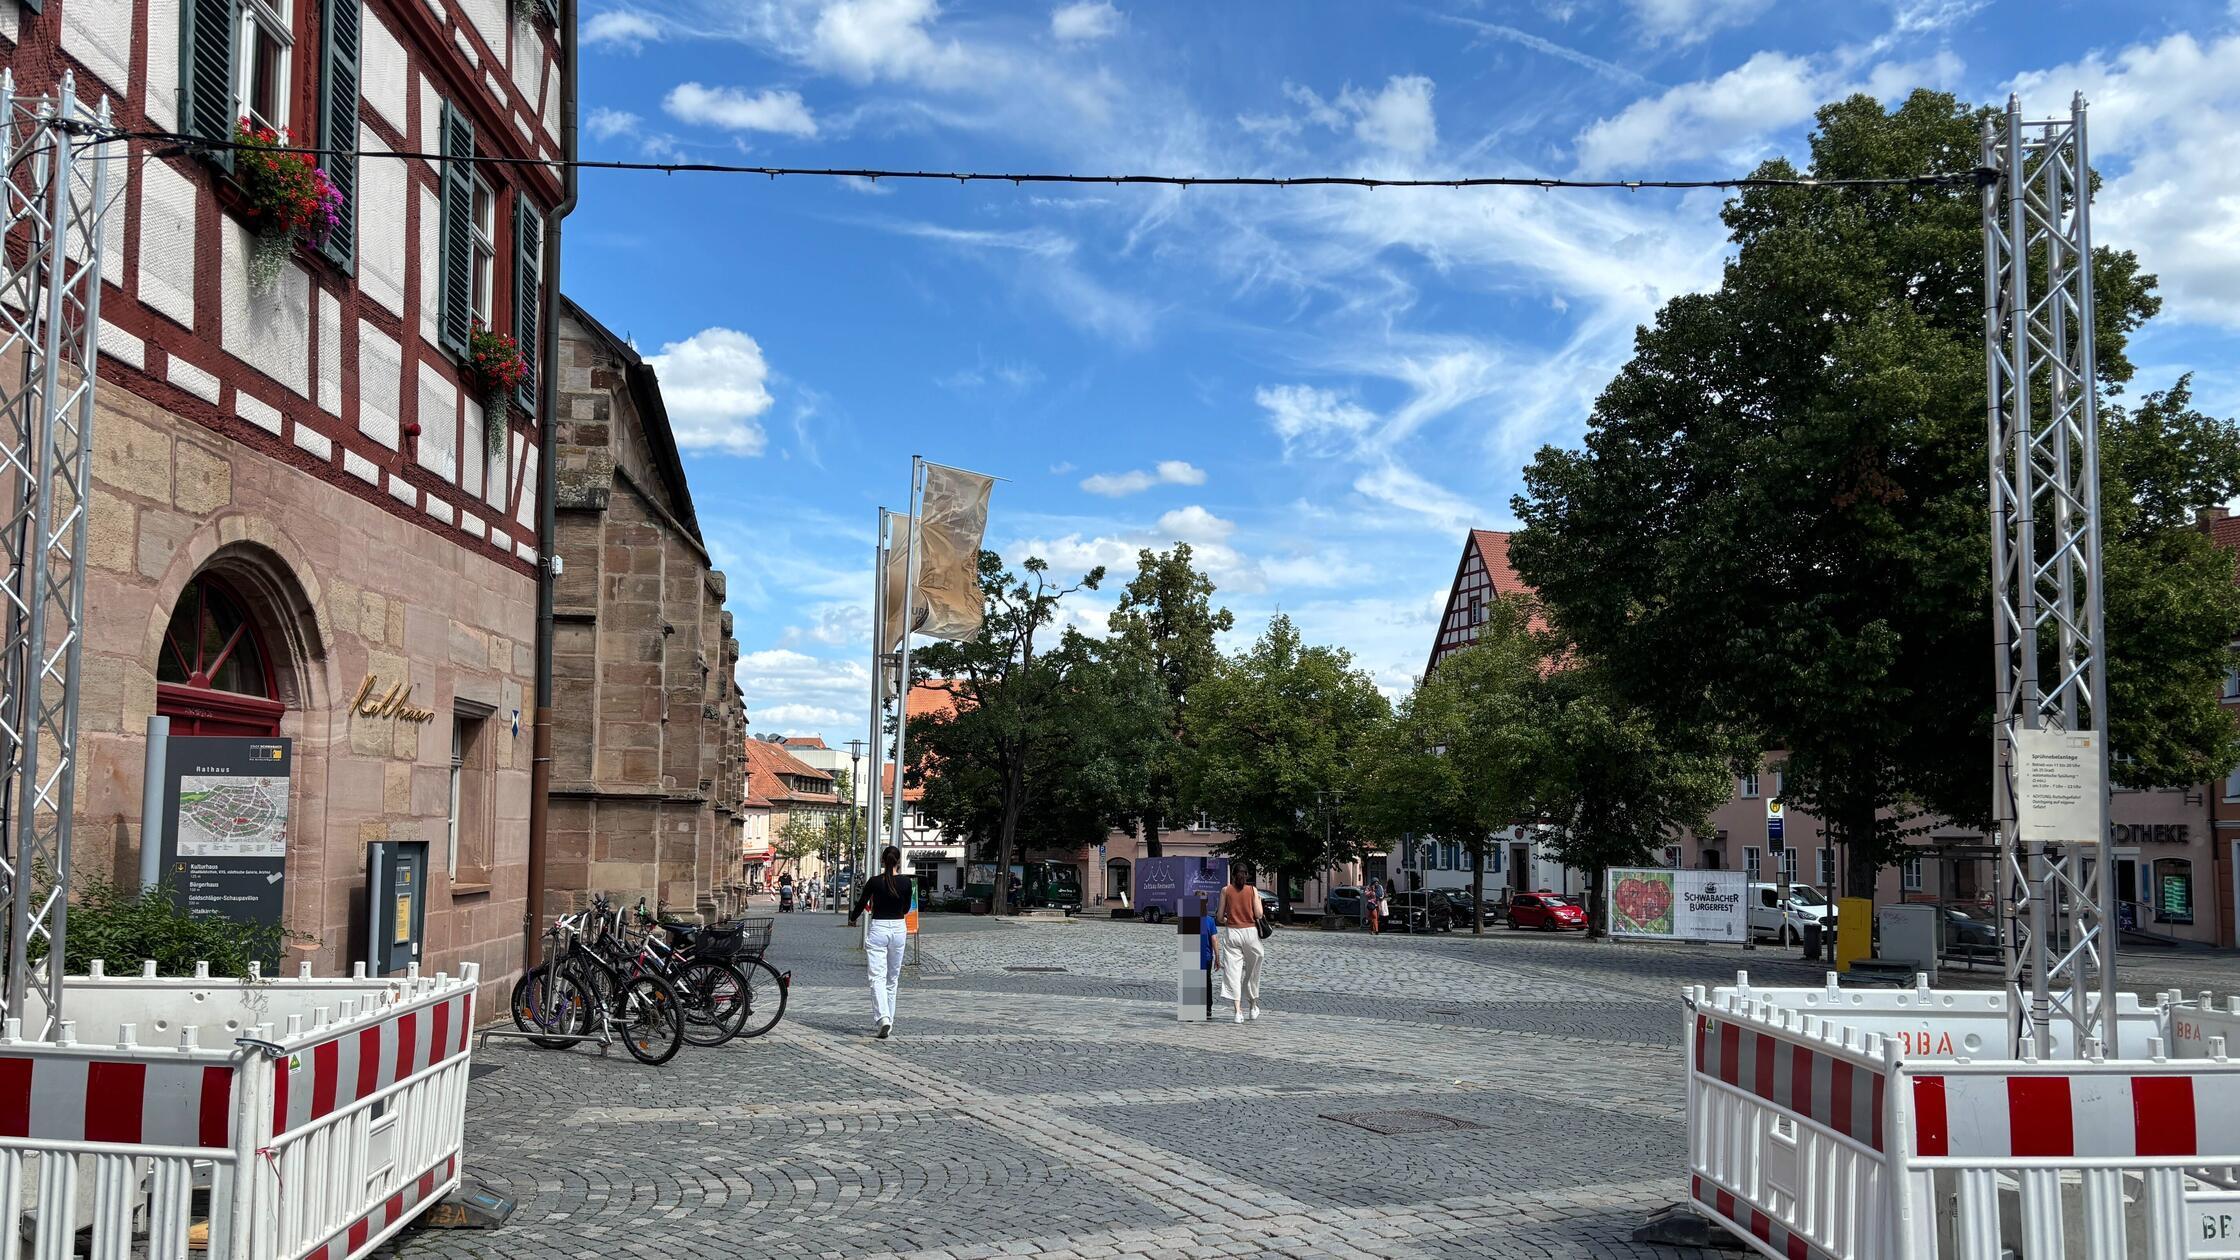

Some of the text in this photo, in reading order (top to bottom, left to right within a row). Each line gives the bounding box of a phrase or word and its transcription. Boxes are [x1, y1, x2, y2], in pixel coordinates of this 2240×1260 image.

[348, 671, 435, 725] Rathaus
[2111, 824, 2189, 845] OTHEKE
[1684, 892, 1739, 903] SCHWABACHER
[1689, 902, 1734, 913] BÜRGERFEST
[2176, 1021, 2201, 1041] BBA
[1897, 1031, 1953, 1055] BBA
